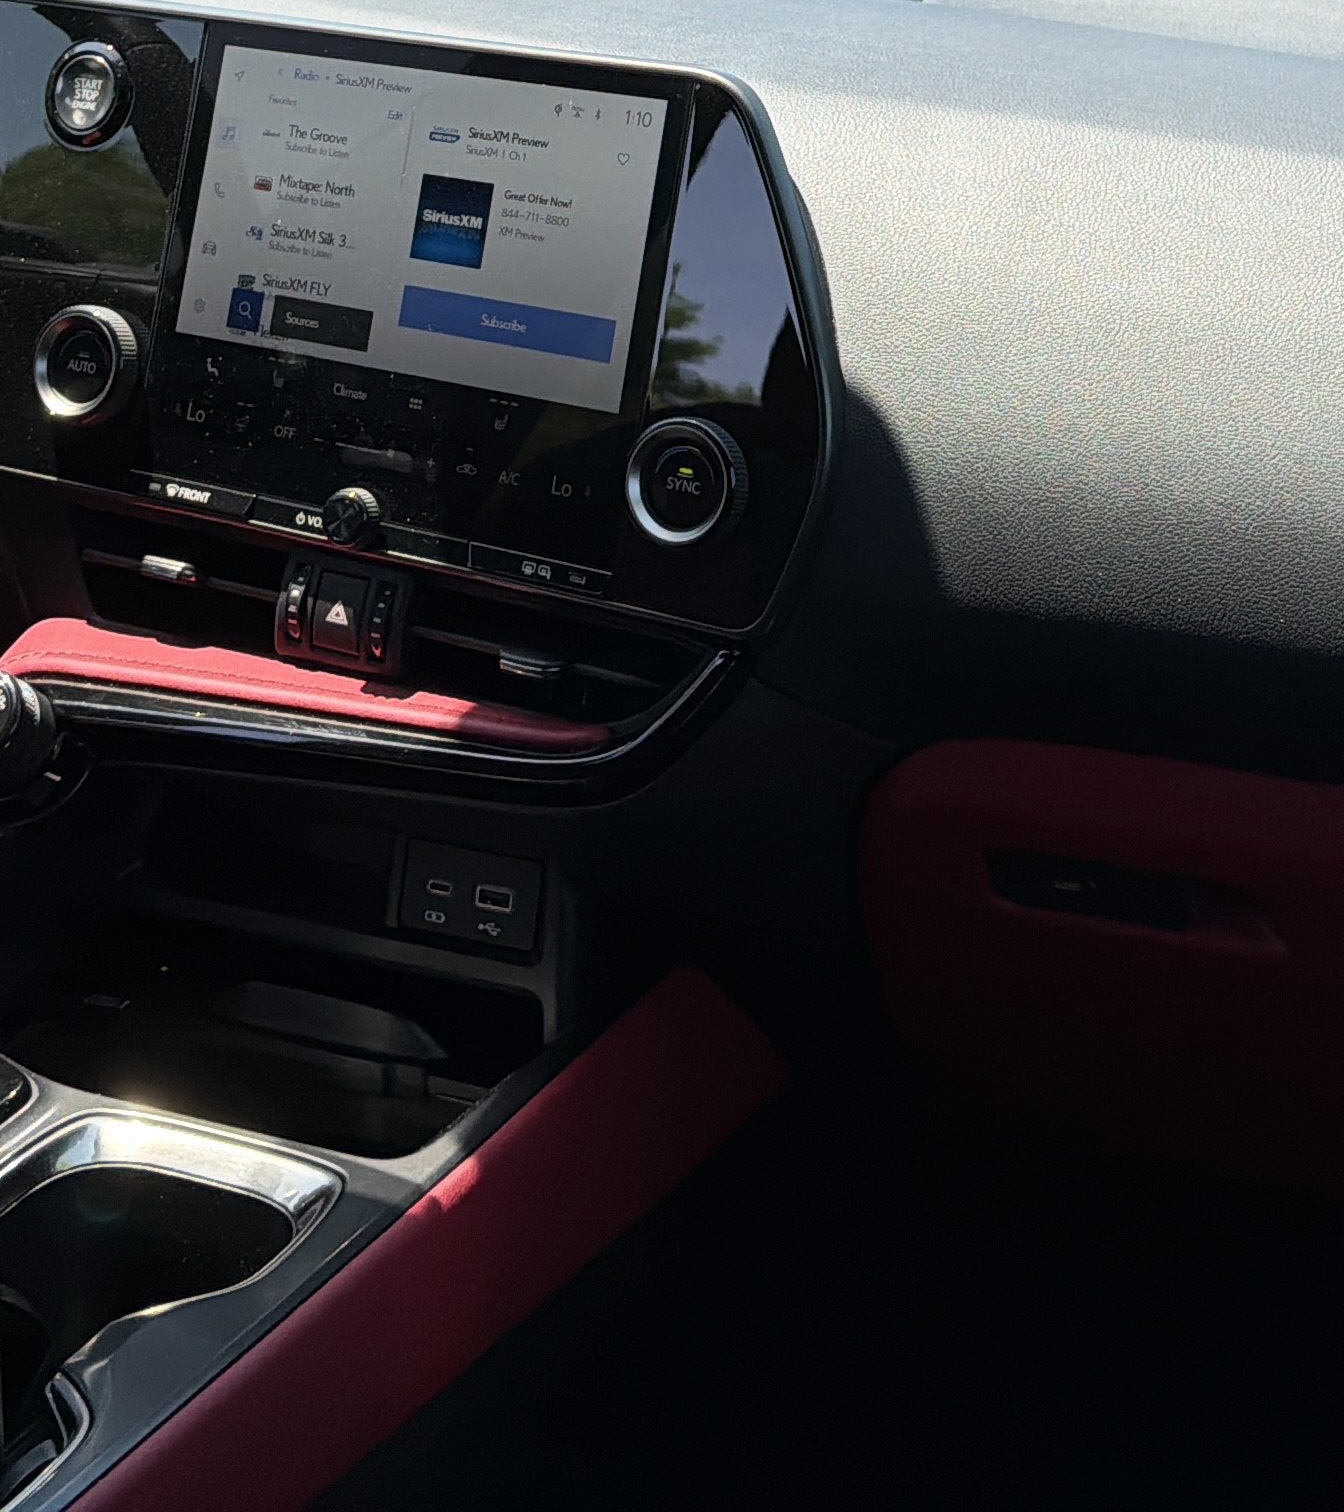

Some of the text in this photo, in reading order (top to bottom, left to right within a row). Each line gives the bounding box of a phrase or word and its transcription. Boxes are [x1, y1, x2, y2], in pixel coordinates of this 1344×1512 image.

[74, 79, 103, 90] START
[294, 68, 412, 94] Radio SiriusXM Preview
[74, 89, 100, 100] STOP
[387, 110, 403, 121] Edit
[625, 109, 653, 128] 1:10
[289, 124, 307, 139] The
[310, 128, 348, 145] Groove
[468, 127, 550, 149] SiriusXM Preview
[285, 141, 350, 159] Subscribe to Listen
[465, 145, 498, 159] SiriusXM
[509, 150, 521, 162] Ch
[279, 174, 321, 193] Mixtape:
[325, 181, 355, 198] North
[277, 191, 341, 209] Subscribe to Listen
[504, 189, 573, 209] Great Offer Now!
[423, 208, 483, 230] SiriusXM
[501, 207, 570, 228] 844-711-8800
[270, 223, 316, 243] SiriusXM
[318, 231, 336, 246] Silk
[498, 226, 545, 243] XM Preview
[268, 240, 302, 255] Subscribe
[303, 245, 311, 256] to
[262, 273, 307, 293] SiriusXM
[309, 281, 332, 297] FLY
[284, 311, 320, 330] Sources
[481, 313, 527, 333] Subscribe
[66, 358, 97, 375] AUTO
[333, 382, 368, 401] Climate
[187, 399, 206, 423] Lo
[273, 425, 297, 441] OFF
[498, 468, 521, 488] A/C
[551, 474, 573, 498] Lo
[666, 475, 701, 496] SYNC
[177, 488, 212, 505] FRONT
